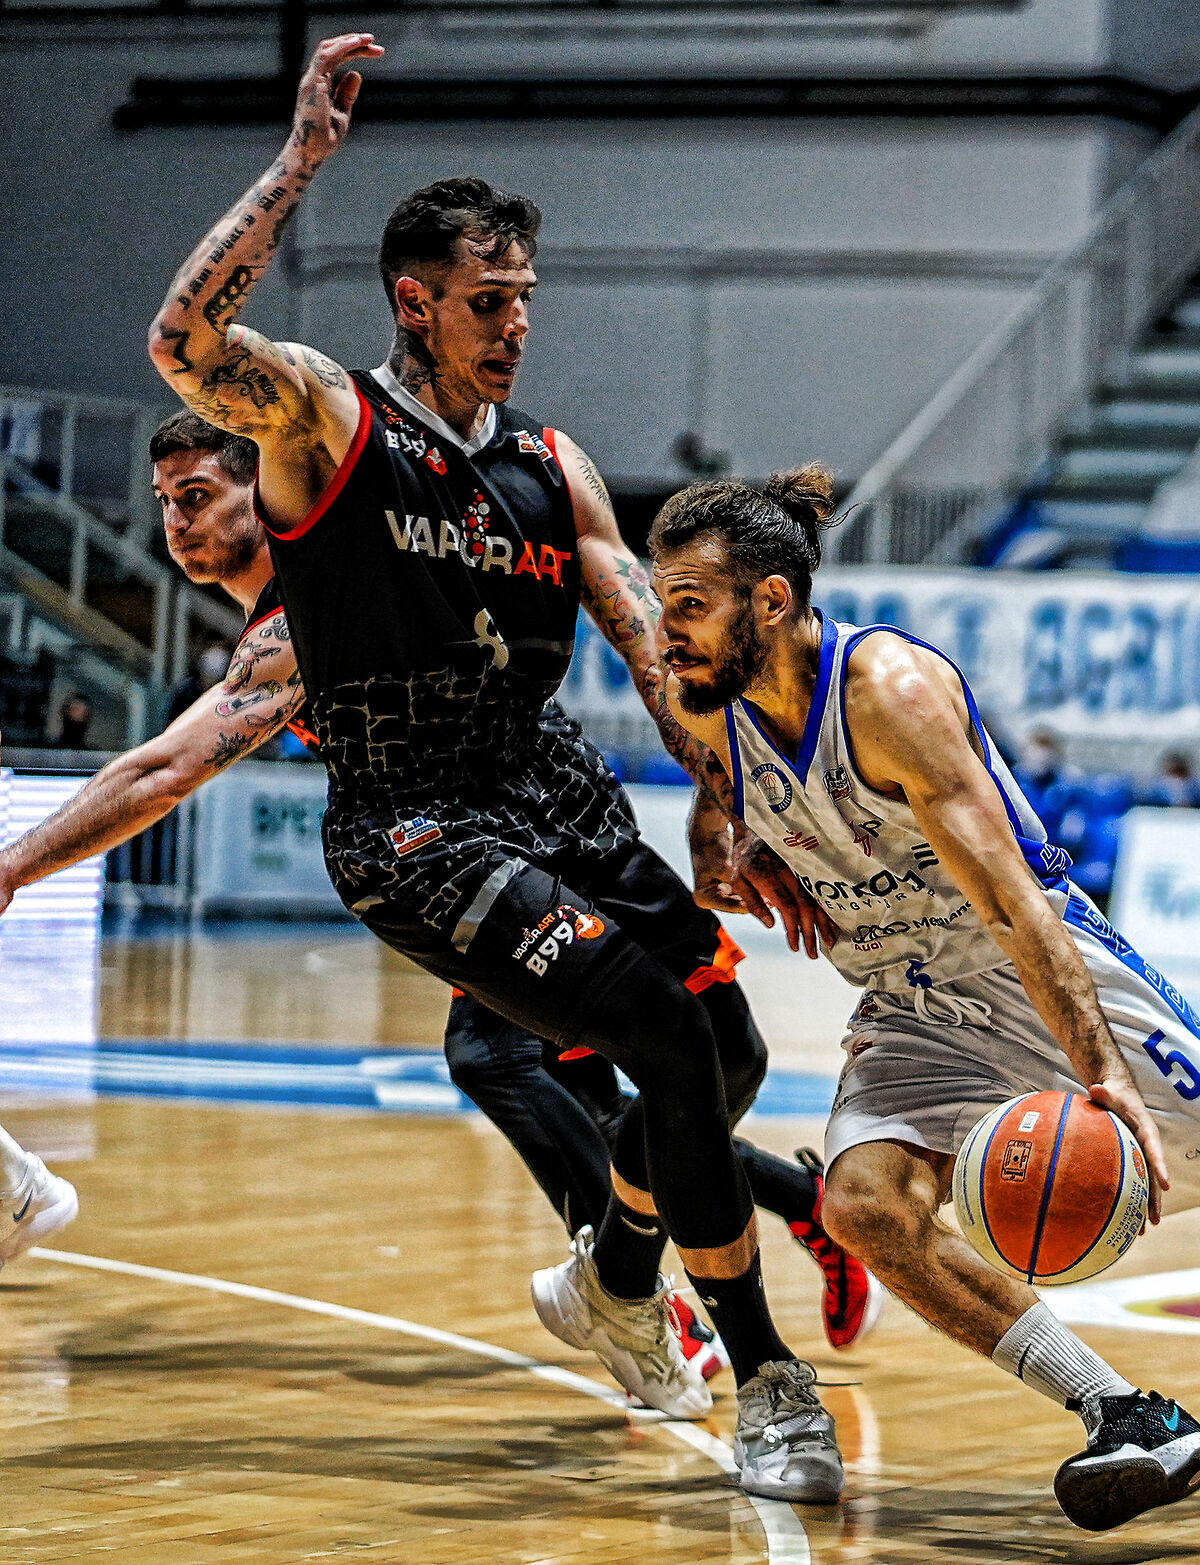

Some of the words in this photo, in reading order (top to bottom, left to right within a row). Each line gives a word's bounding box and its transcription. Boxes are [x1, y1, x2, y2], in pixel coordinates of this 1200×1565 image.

[384, 510, 572, 588] VAPORART
[512, 912, 556, 960] VAPORART
[526, 921, 574, 977] B99
